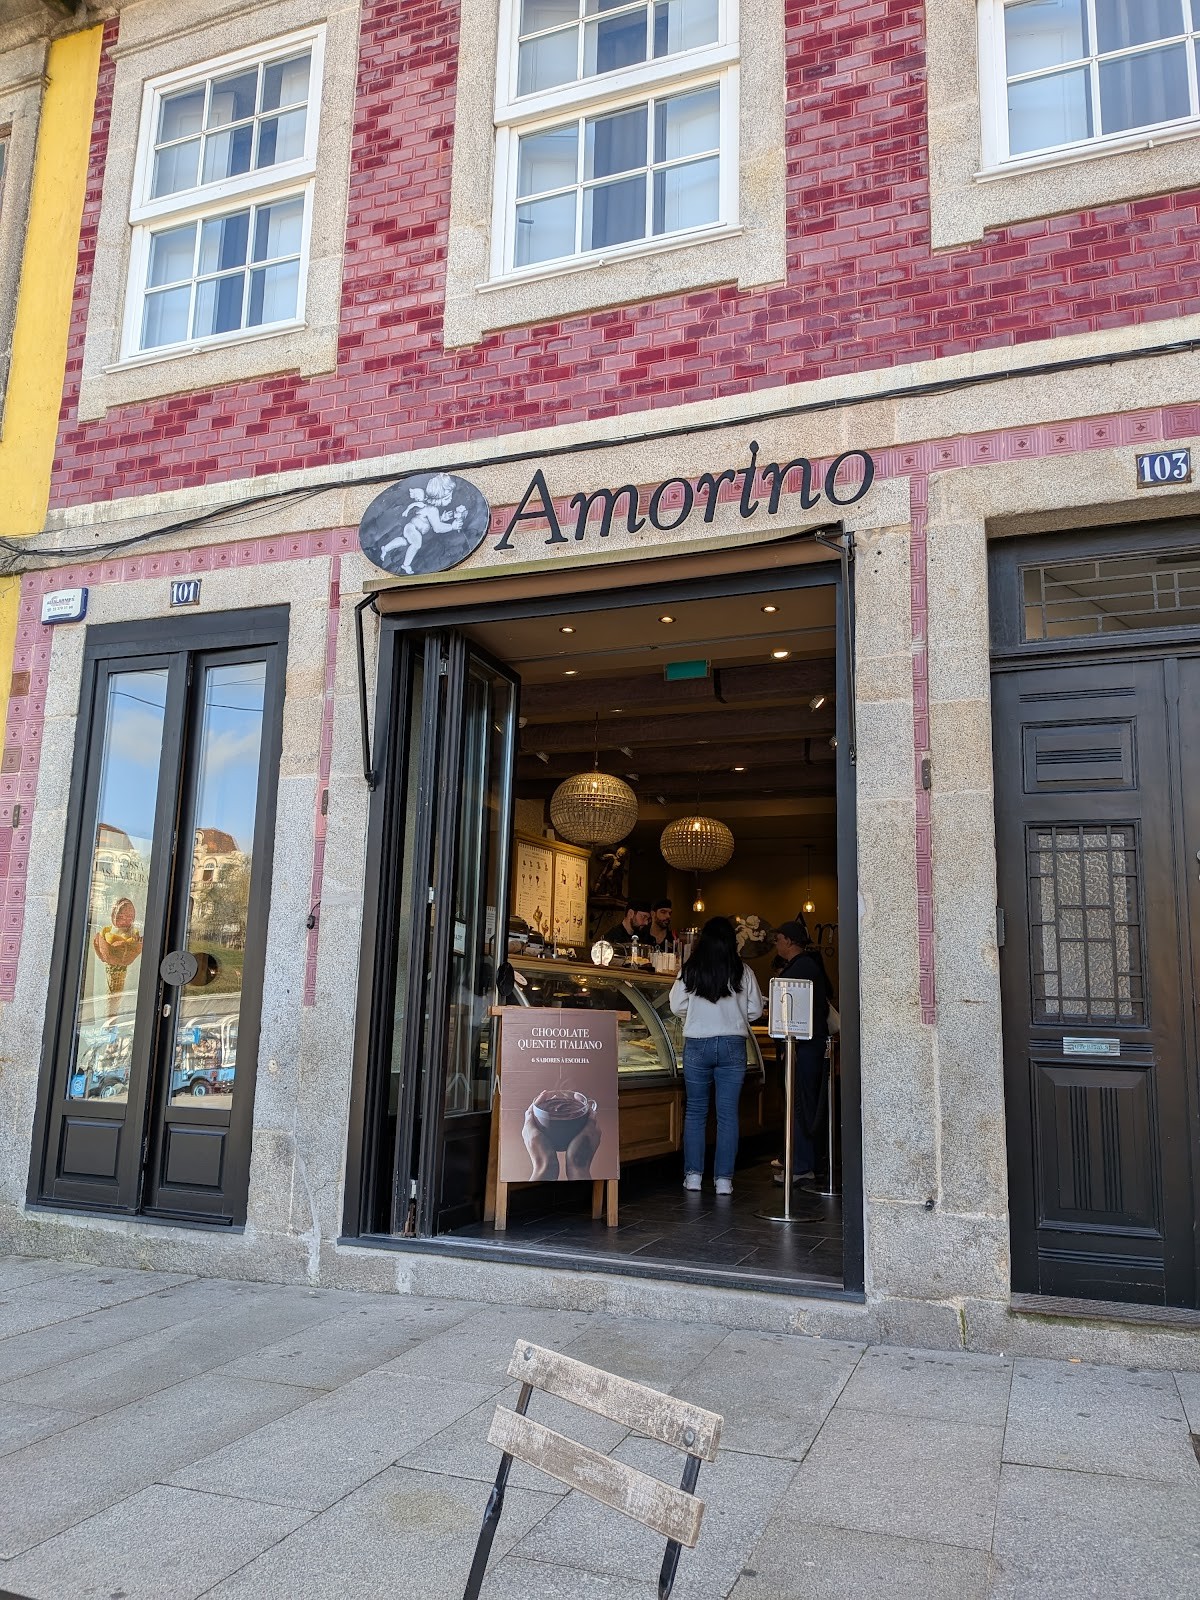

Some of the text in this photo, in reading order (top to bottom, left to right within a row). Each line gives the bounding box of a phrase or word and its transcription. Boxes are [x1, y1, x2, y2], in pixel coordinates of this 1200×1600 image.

[1141, 453, 1187, 482] 103
[493, 440, 875, 551] Amorino
[172, 582, 195, 604] 101
[531, 1027, 590, 1038] CHOCOLATE
[517, 1039, 603, 1051] QUENTE ITALIANO
